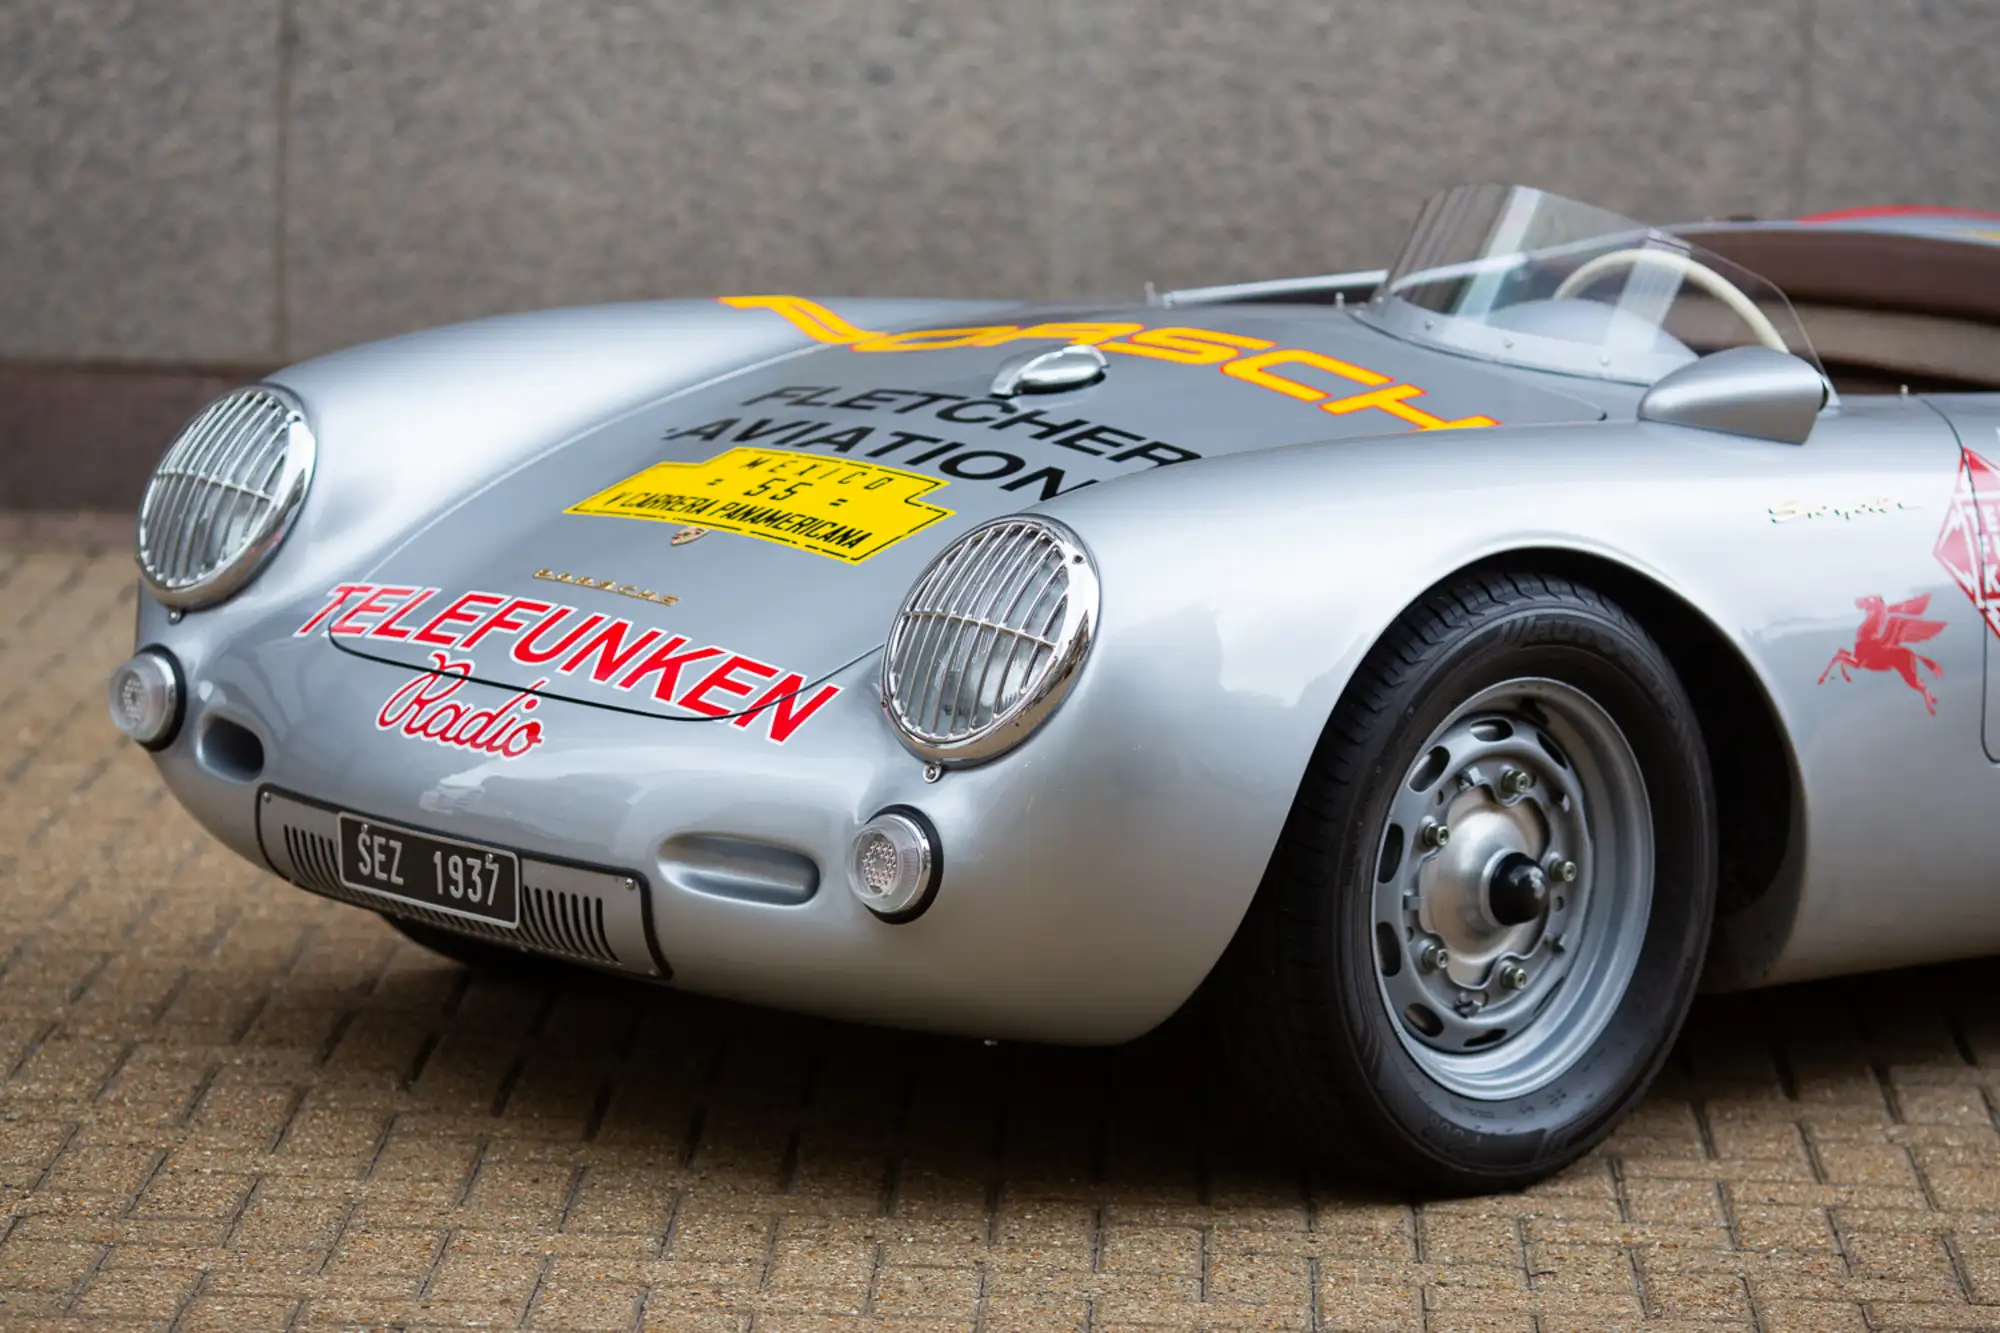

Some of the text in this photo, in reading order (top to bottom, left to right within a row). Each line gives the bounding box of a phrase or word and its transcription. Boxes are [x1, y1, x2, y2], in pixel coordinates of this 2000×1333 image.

[718, 295, 1502, 432] PORSCH
[660, 417, 1101, 501] AVIATION
[741, 385, 1203, 470] FLETCHER
[737, 455, 896, 491] MEXICO
[742, 477, 814, 501] 55
[619, 491, 720, 515] CARRERA
[706, 501, 874, 549] PANAMERICANA
[292, 581, 844, 746] TELEFUNKEN
[375, 650, 546, 761] Radio
[358, 831, 499, 906] SEZ 1937
